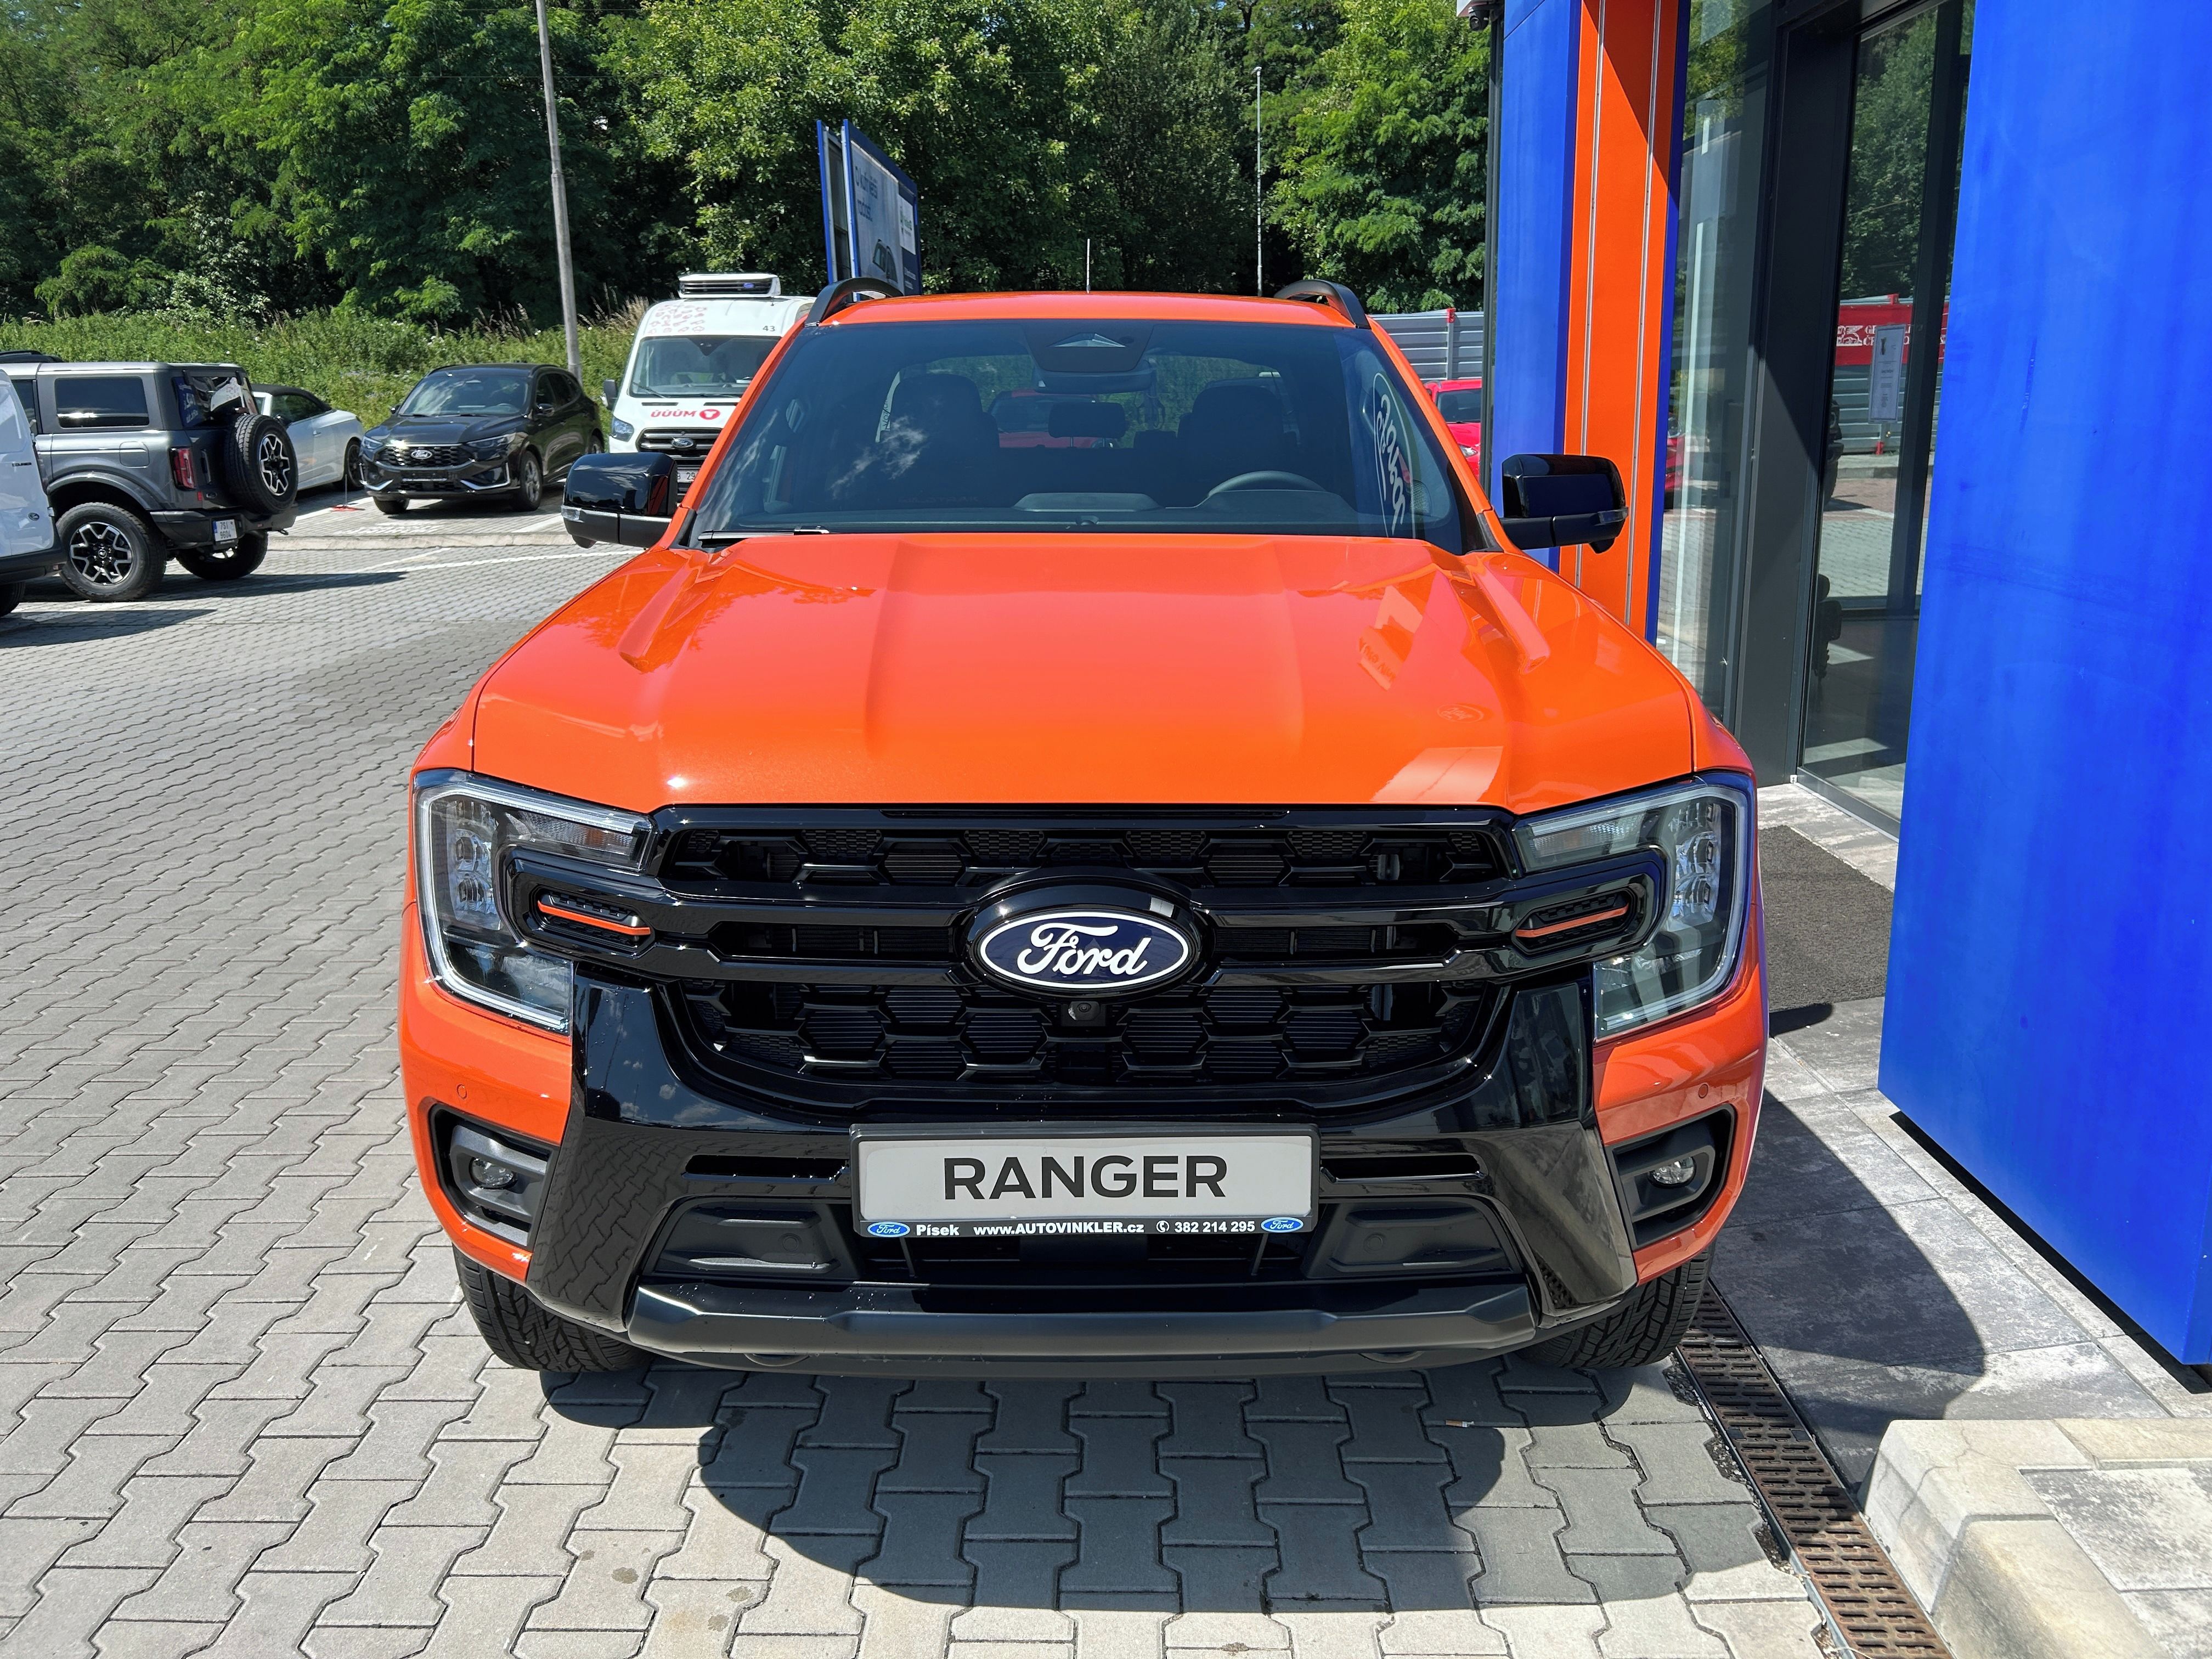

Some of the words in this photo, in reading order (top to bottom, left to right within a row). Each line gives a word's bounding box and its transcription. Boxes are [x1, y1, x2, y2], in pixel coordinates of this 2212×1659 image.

[1017, 922, 1152, 975] Ford
[944, 1155, 1227, 1200] RANGER
[916, 1224, 960, 1236] Písek
[973, 1222, 1144, 1235] www.AUTOVINKLER.cz
[1175, 1221, 1199, 1233] 382
[1203, 1221, 1227, 1233] 214
[1231, 1221, 1255, 1232] 295
